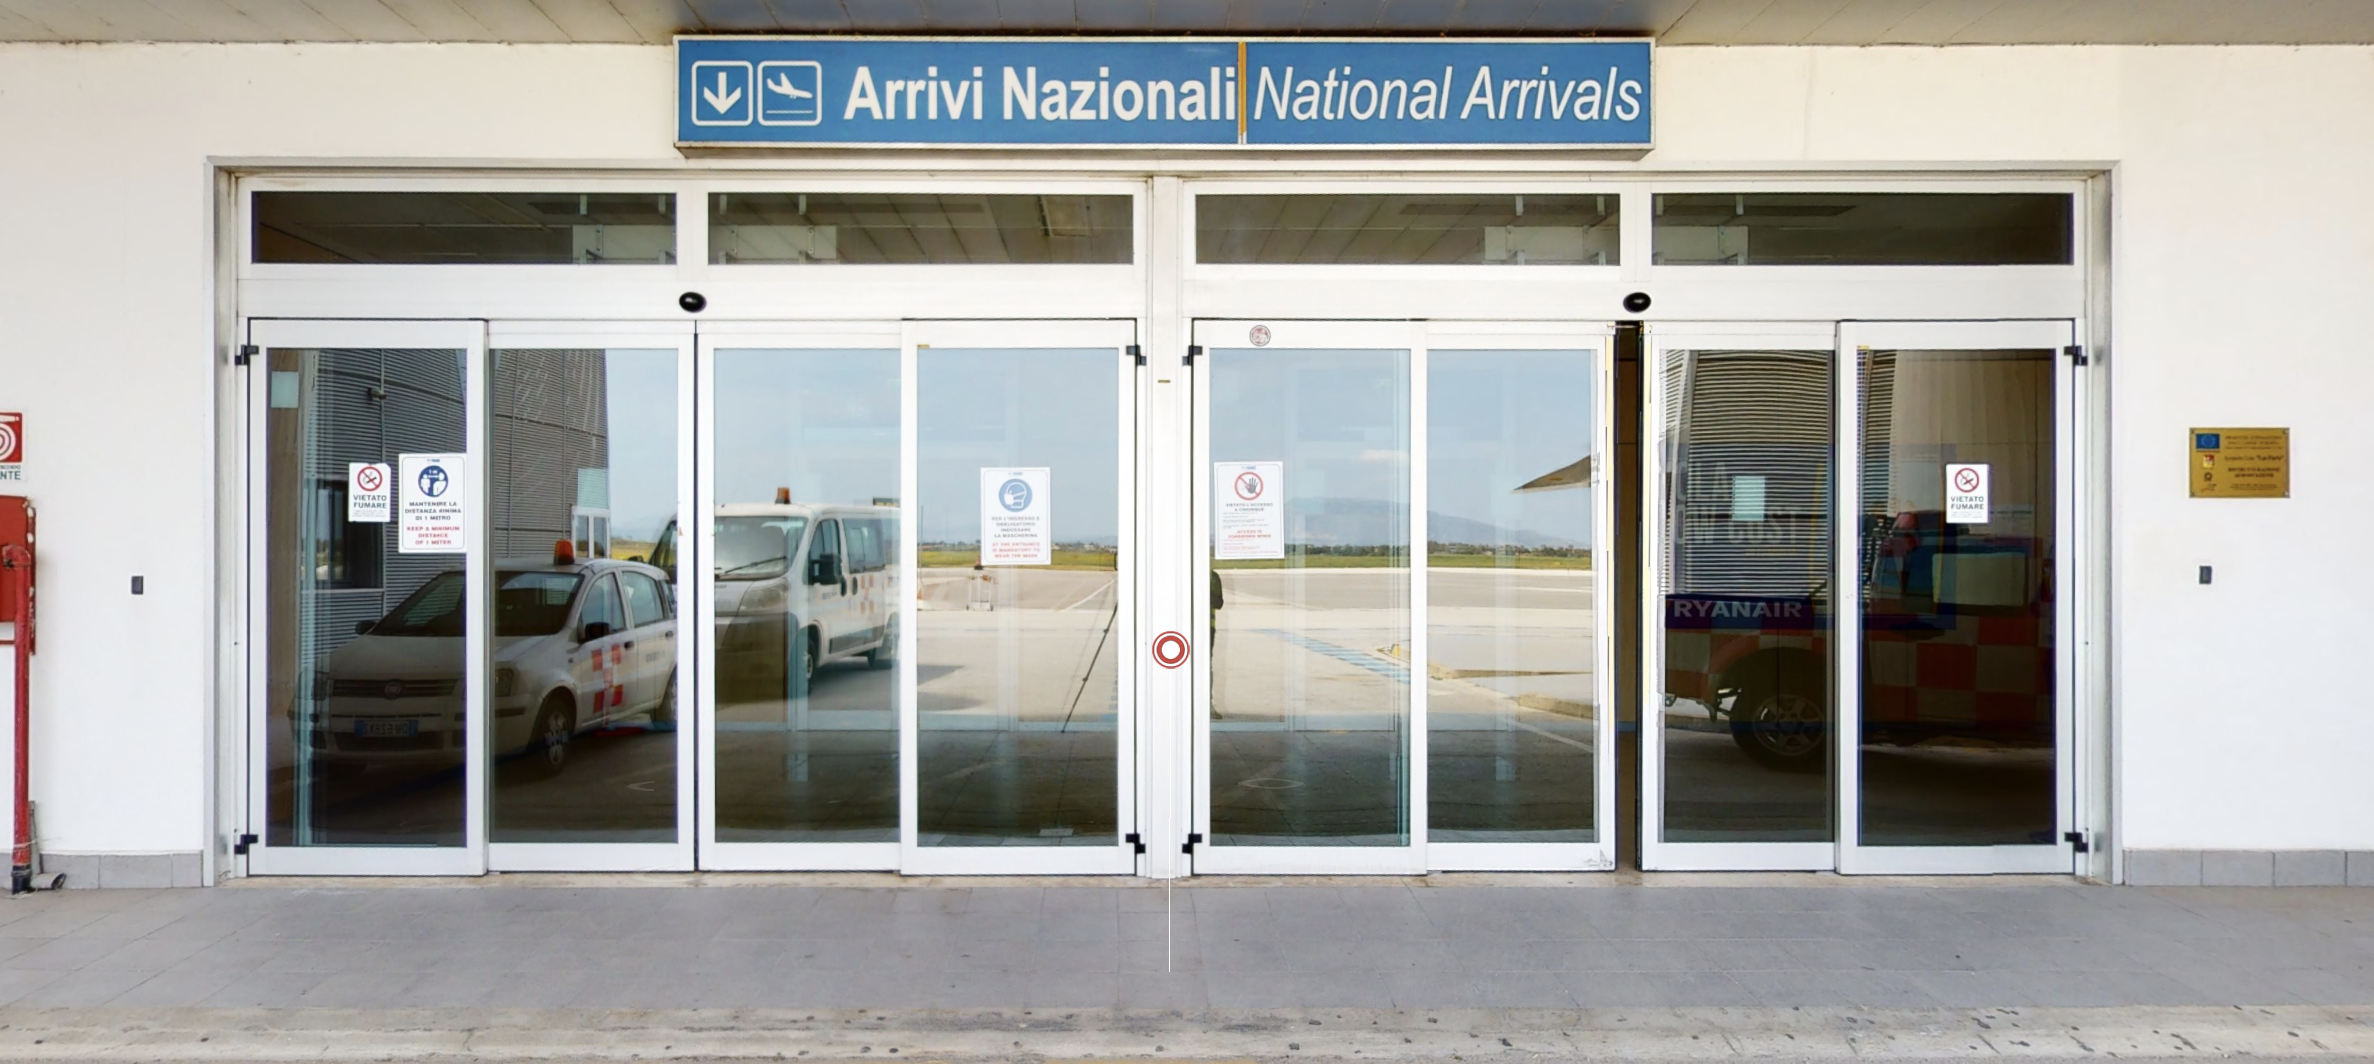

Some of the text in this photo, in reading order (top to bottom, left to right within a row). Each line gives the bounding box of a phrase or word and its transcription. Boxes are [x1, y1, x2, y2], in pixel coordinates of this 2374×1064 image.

[843, 66, 1236, 121] Arrivi Nazionali
[1253, 66, 1643, 121] National Arrivals
[0, 470, 21, 480] NTE
[1674, 600, 1802, 618] RYANAIR
